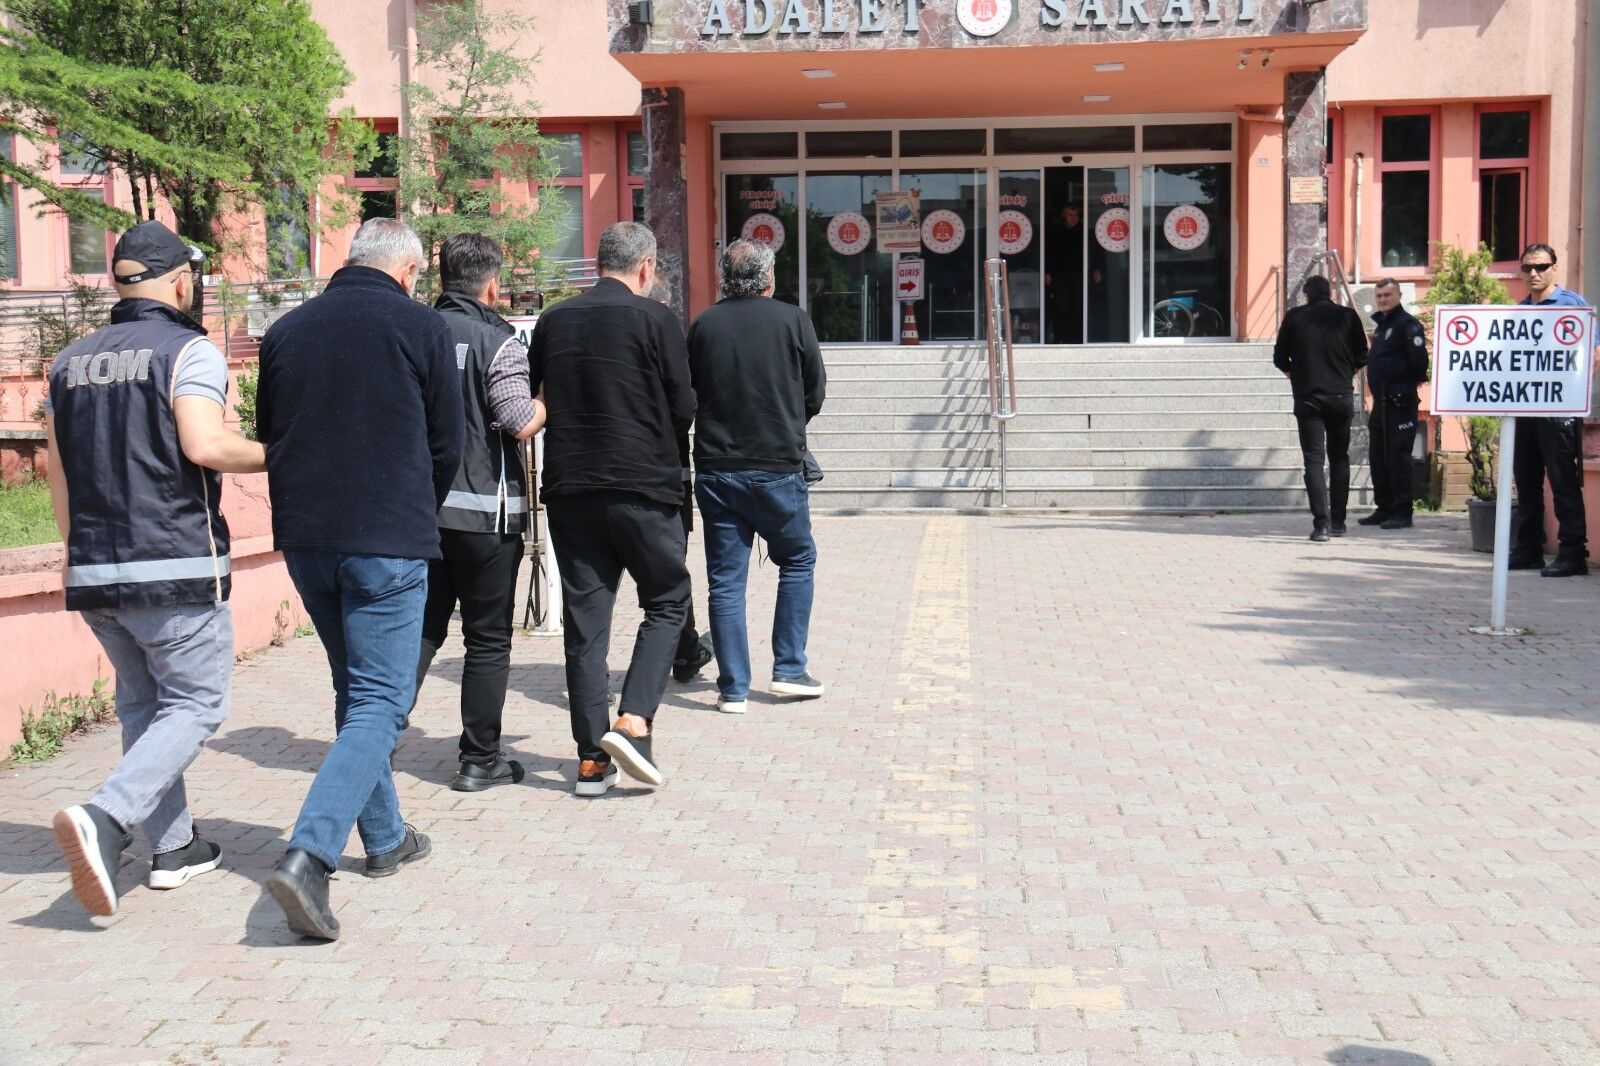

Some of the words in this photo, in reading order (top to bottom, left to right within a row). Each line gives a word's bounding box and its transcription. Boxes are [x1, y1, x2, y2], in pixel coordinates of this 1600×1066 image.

[702, 0, 924, 36] ADALET
[1487, 318, 1543, 346] ARAÇ
[66, 348, 153, 389] KOM
[1448, 350, 1503, 372] PARK
[1509, 349, 1578, 372] ETMEK
[1462, 380, 1563, 403] YASAKTIR
